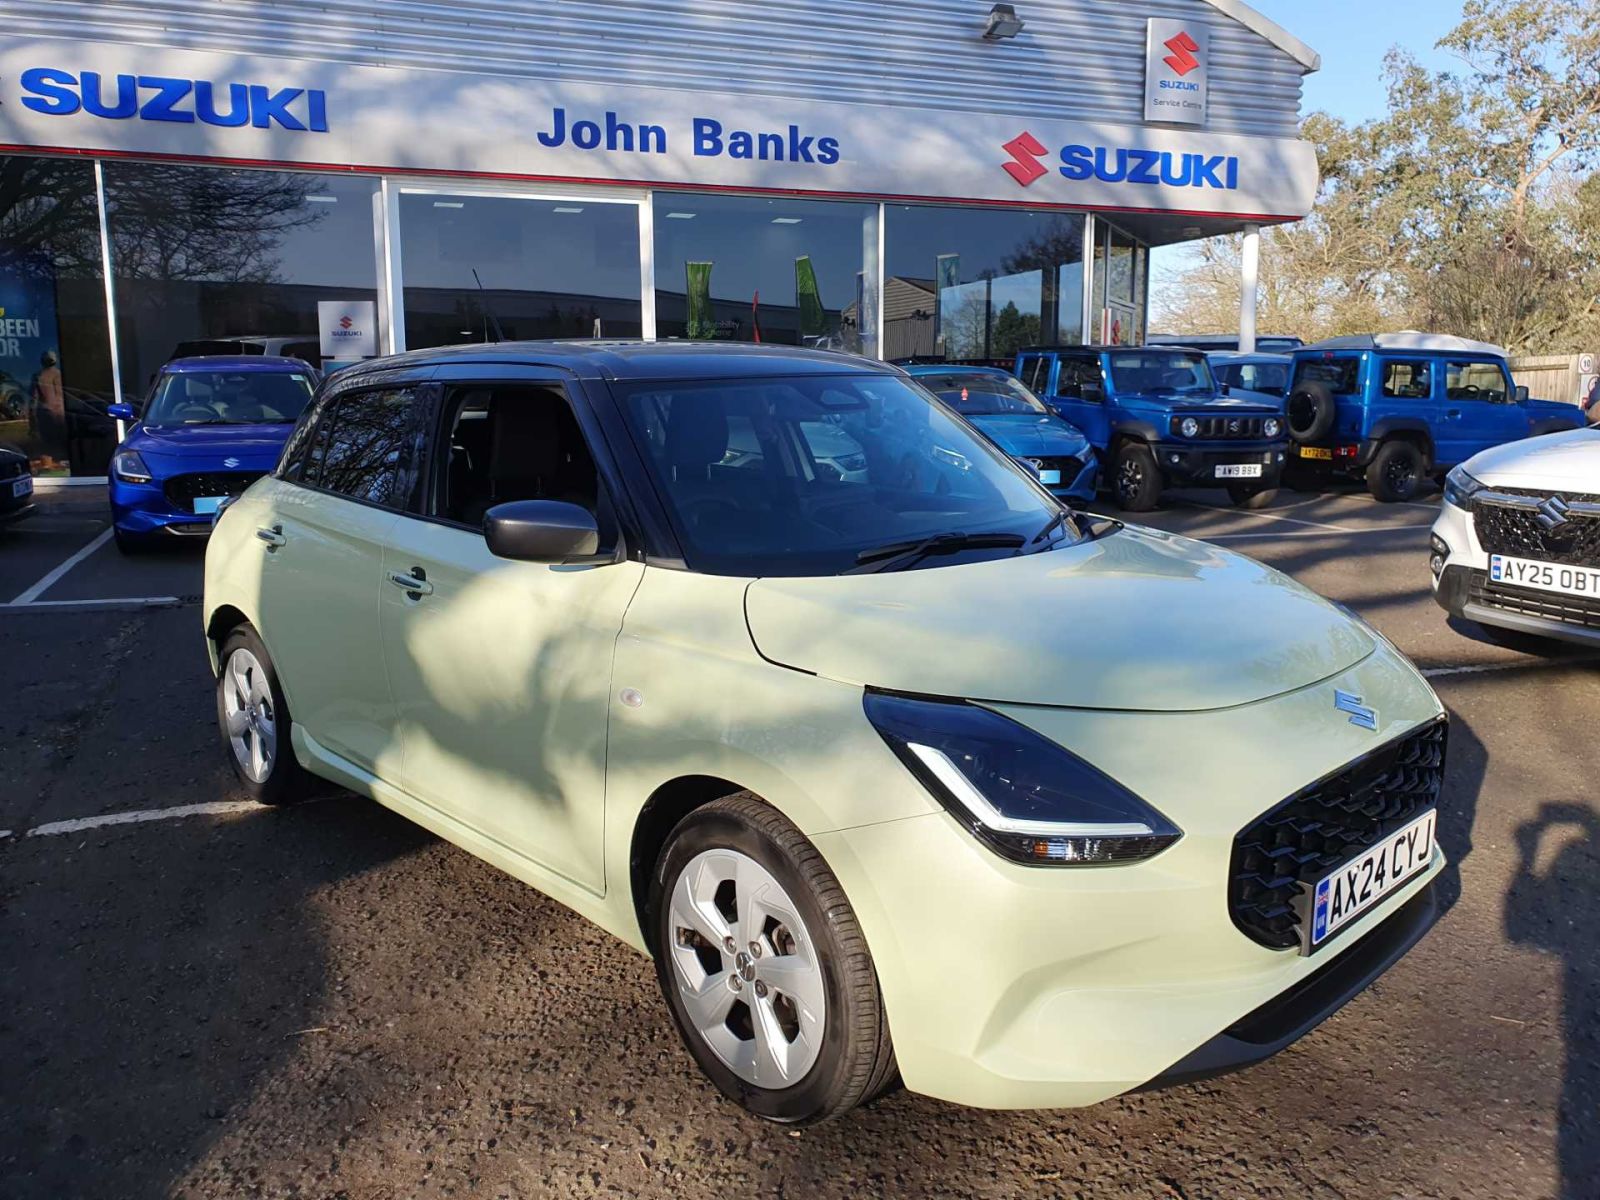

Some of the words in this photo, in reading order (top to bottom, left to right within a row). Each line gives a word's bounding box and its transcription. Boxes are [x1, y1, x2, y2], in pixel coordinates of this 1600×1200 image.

[21, 68, 328, 132] SUZUKI
[1153, 98, 1180, 108] Service
[1160, 80, 1200, 92] SUZUKI
[537, 108, 667, 153] John
[693, 117, 840, 164] Banks
[1059, 144, 1238, 190] SUZUKI
[1584, 359, 1591, 368] 10
[1504, 560, 1553, 586] AY25
[1560, 569, 1600, 593] OBT
[1330, 847, 1387, 924] AX24
[1392, 819, 1432, 879] CYJ
